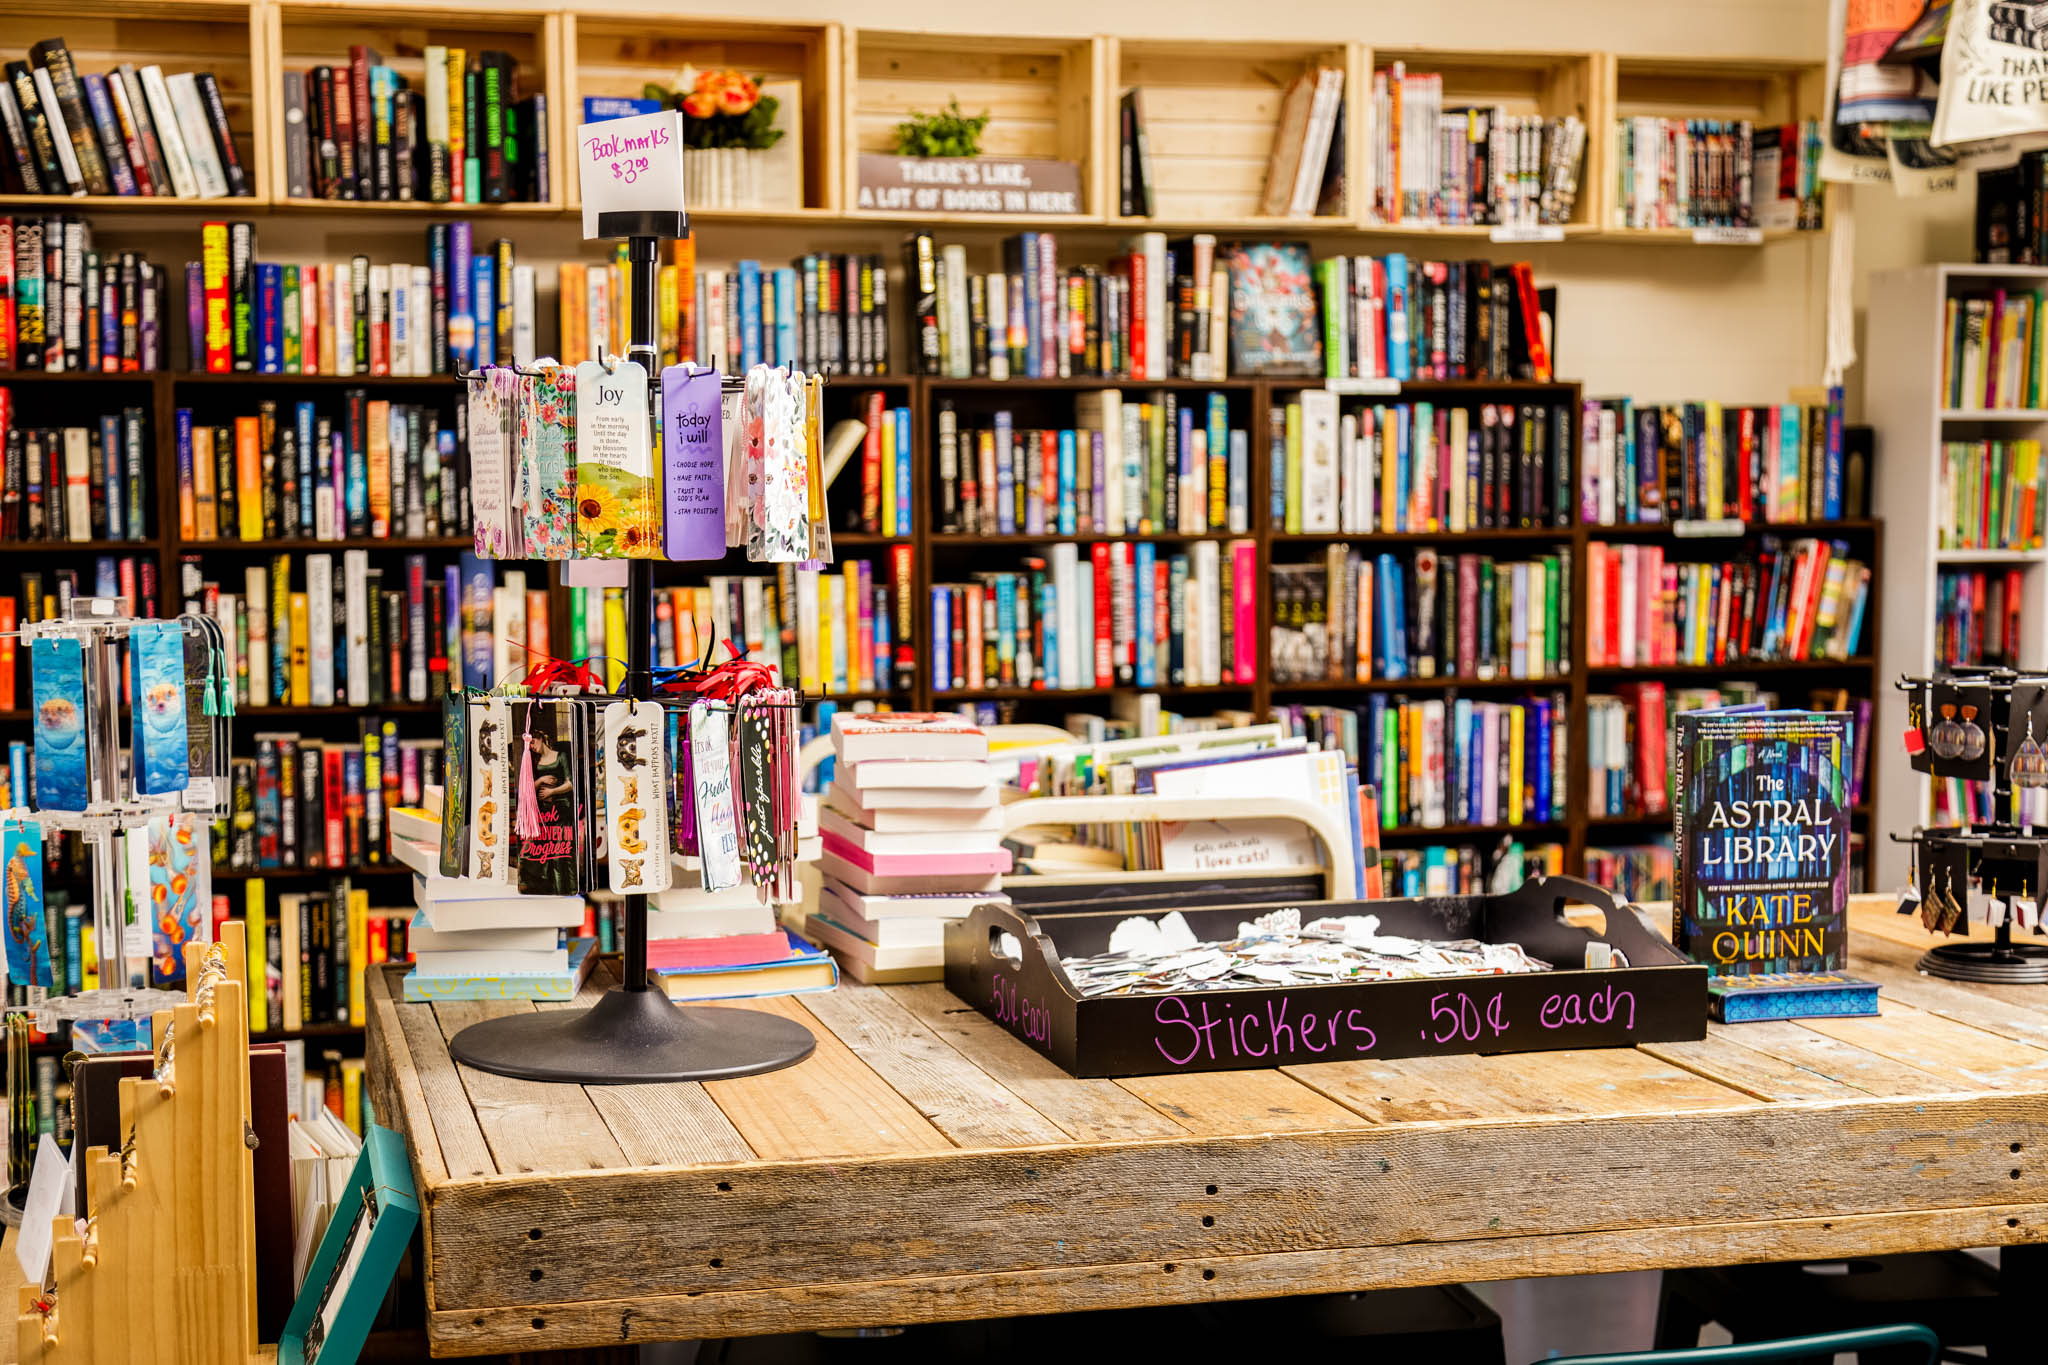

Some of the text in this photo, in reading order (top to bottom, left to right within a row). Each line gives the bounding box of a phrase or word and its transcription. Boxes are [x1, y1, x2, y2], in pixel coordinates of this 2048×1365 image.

[1967, 79, 2013, 105] LIKE
[900, 160, 980, 185] THERE'S
[859, 186, 874, 208] A
[876, 187, 913, 209] LOT
[914, 188, 941, 210] OF
[942, 188, 1001, 212] BOOKS
[1004, 190, 1027, 212] IN
[595, 385, 624, 406] Joy
[675, 412, 711, 429] today
[617, 430, 627, 438] day
[680, 430, 708, 445] i will
[700, 460, 714, 468] HOPE
[693, 507, 719, 515] POSITIVE
[651, 722, 659, 745] NEXT?
[1676, 725, 1685, 747] The
[651, 746, 659, 778] HAPPENS
[1758, 749, 1783, 759] A Novel
[1675, 748, 1684, 800] ASTRAL
[1756, 775, 1784, 792] The
[652, 779, 660, 800] WHAT
[750, 742, 774, 843] just sparkle
[1707, 798, 1832, 829] ASTRAL
[563, 825, 573, 841] IN
[1674, 803, 1683, 859] LIBRARY
[520, 840, 573, 864] Progress
[1204, 855, 1231, 868] love
[1237, 848, 1270, 863] cats!
[1703, 833, 1837, 865] LIBRARY
[1673, 868, 1682, 903] KATE
[1726, 894, 1813, 926] KATE
[1712, 927, 1825, 965] QUINN
[1022, 996, 1052, 1049] each
[1154, 984, 1636, 1065] Stickers .50¢ each
